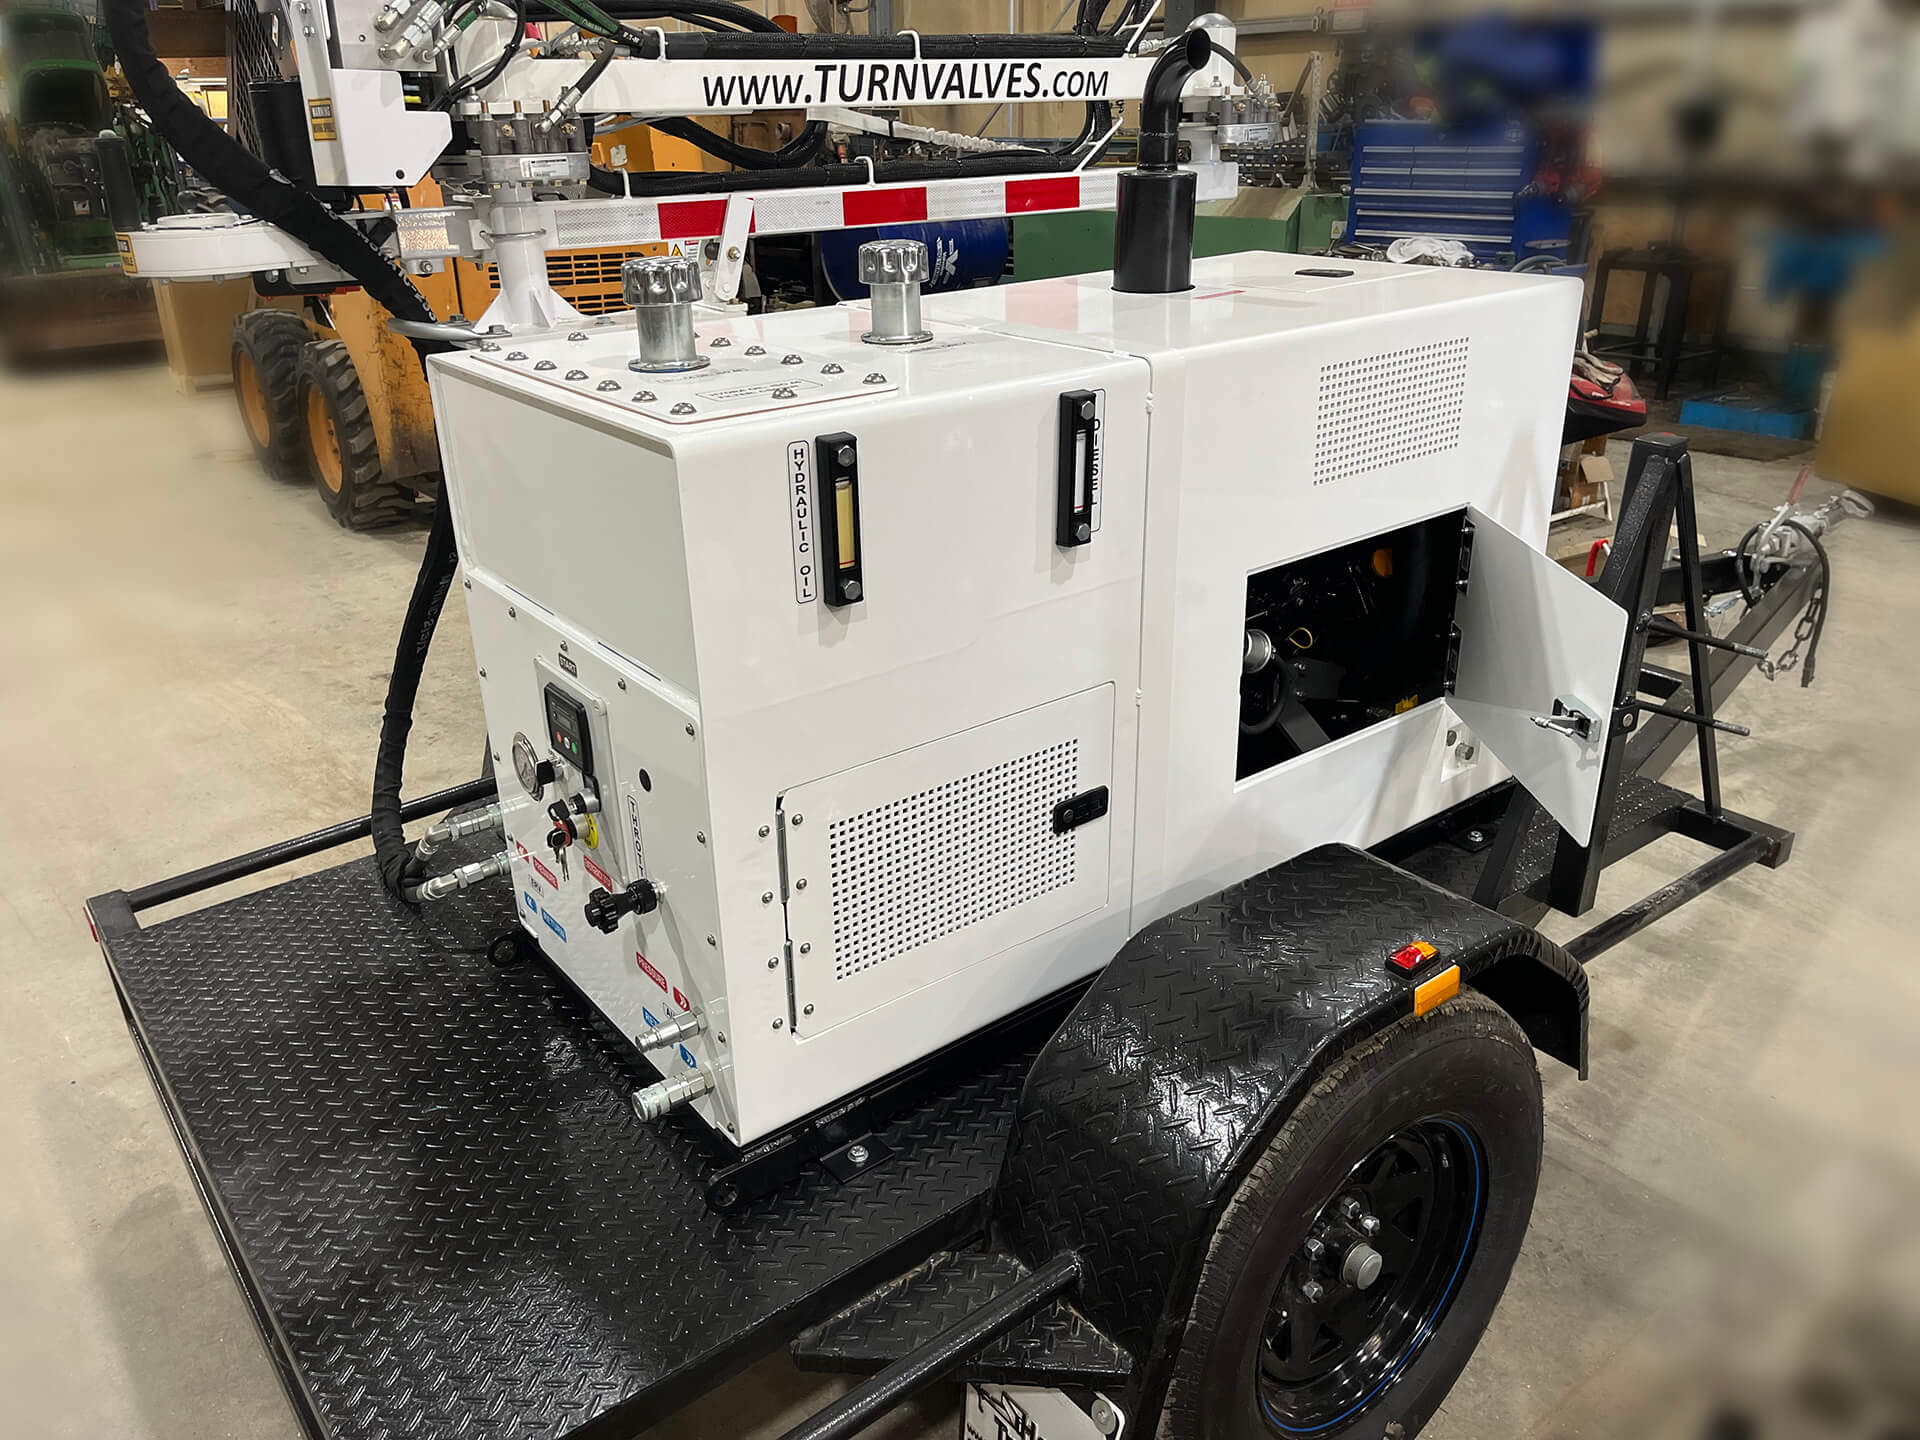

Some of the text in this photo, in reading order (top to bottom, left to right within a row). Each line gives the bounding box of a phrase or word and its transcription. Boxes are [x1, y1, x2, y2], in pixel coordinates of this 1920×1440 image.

[702, 63, 1109, 106] WWW.TURNVALVES.COM
[794, 448, 812, 598] HYDRAULIC OIL
[630, 800, 644, 878] THROTT
